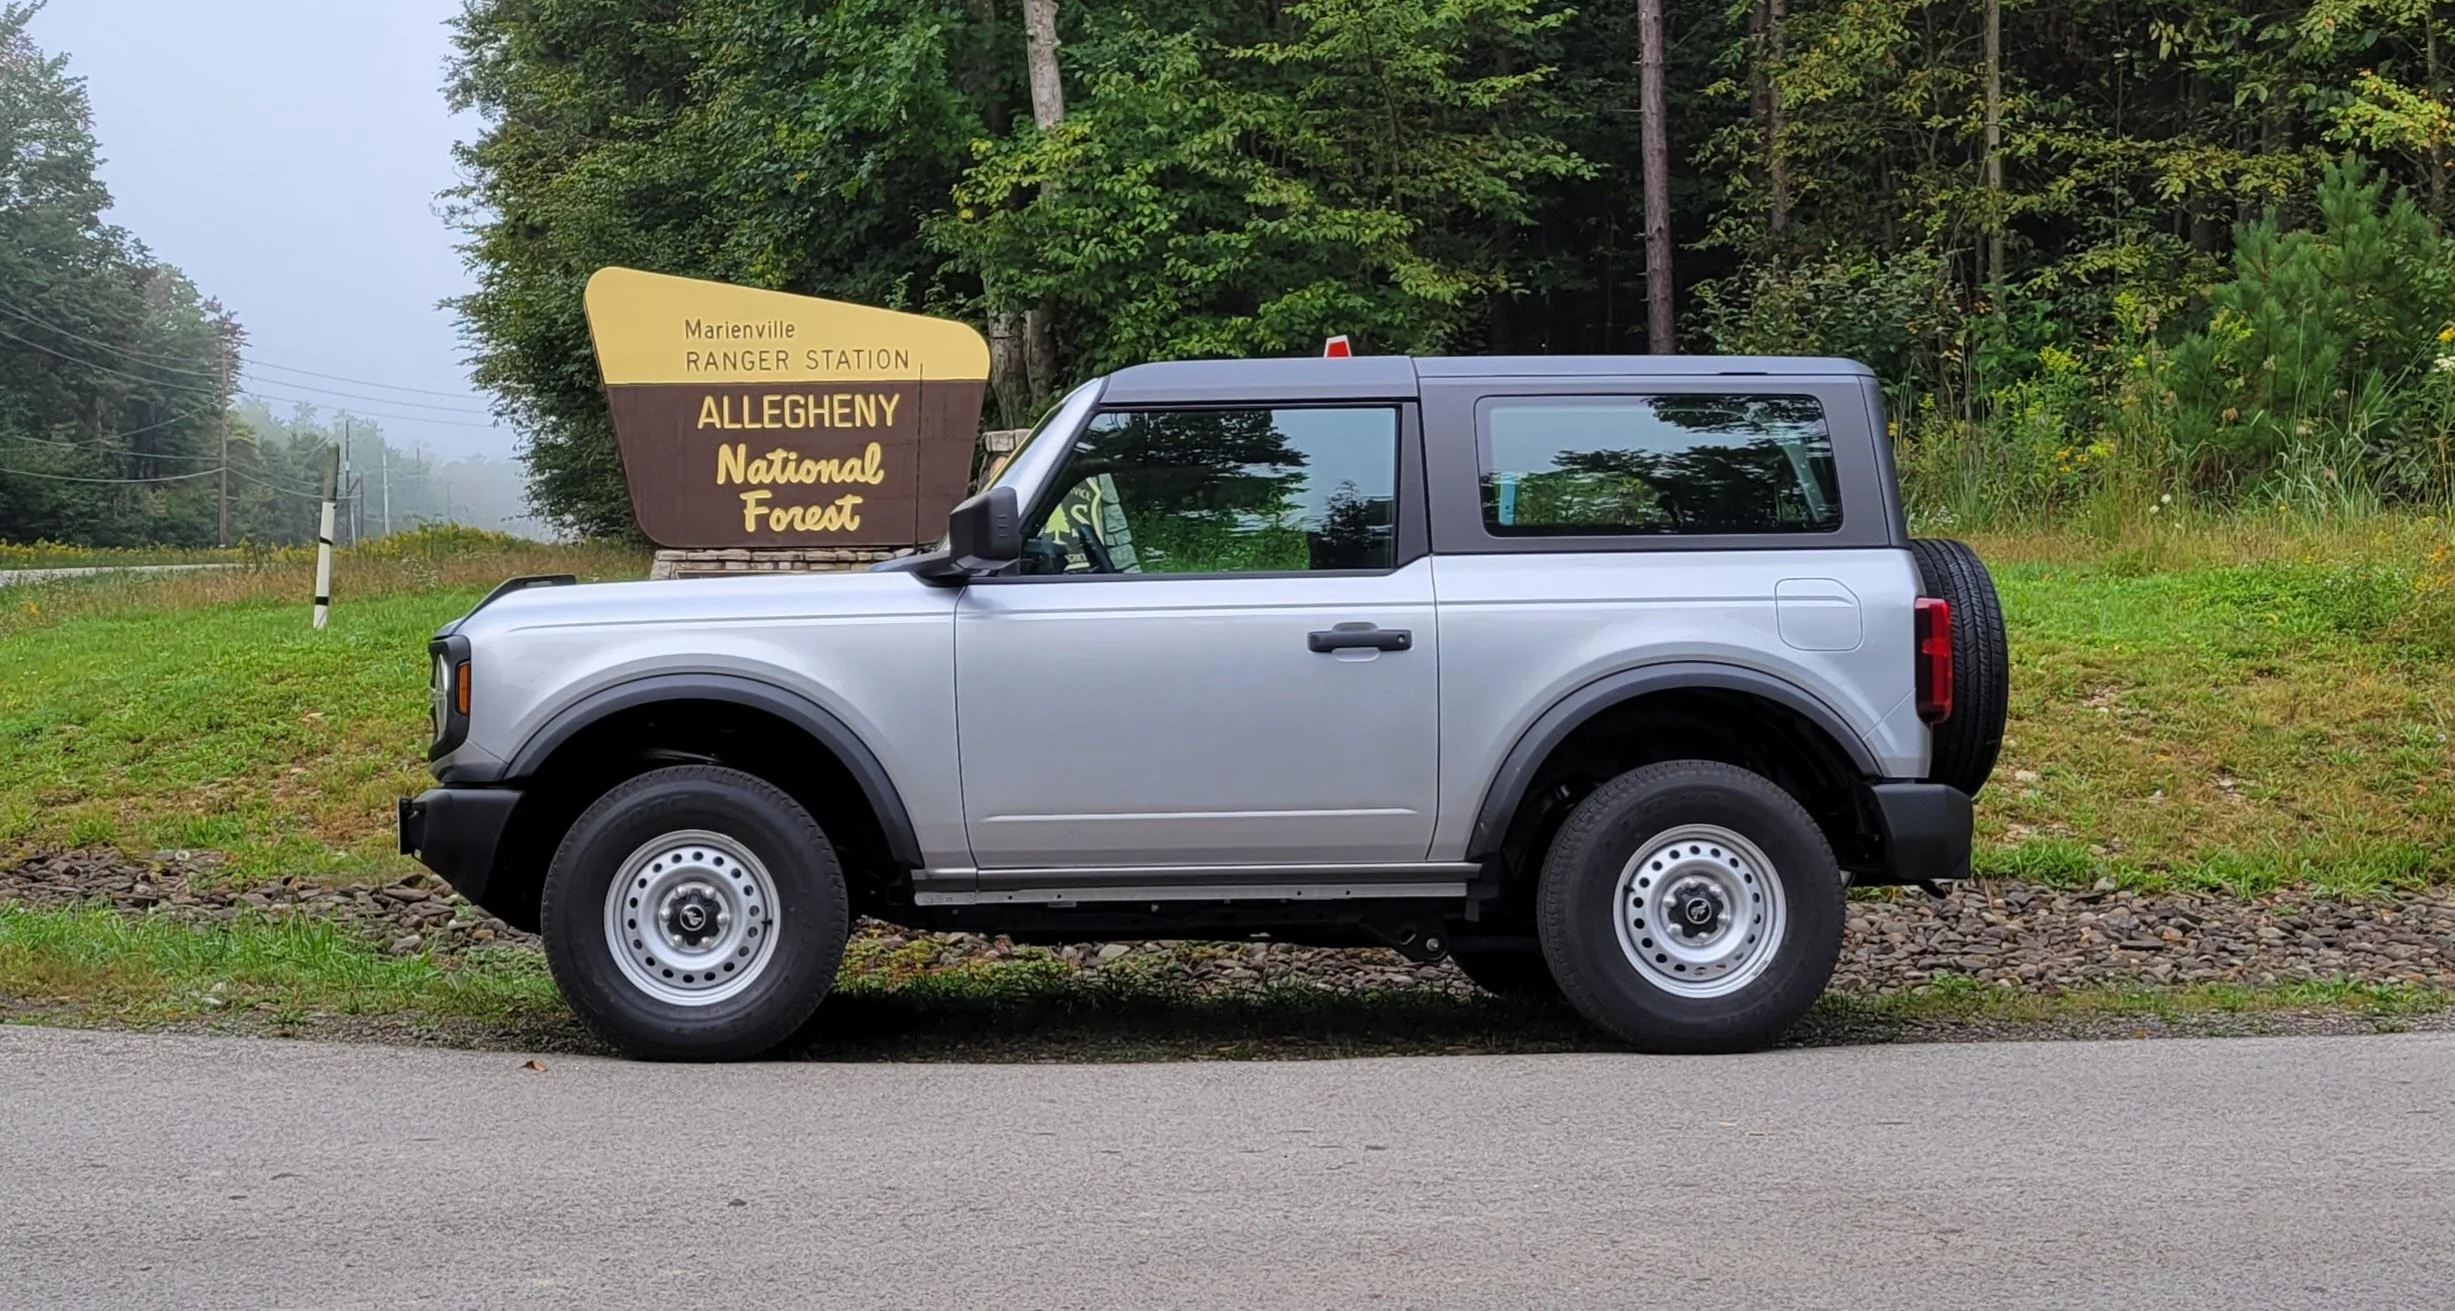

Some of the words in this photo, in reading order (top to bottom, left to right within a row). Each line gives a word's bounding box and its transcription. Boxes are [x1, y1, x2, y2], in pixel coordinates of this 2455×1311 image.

[684, 319, 796, 340] Marienville
[686, 350, 790, 371] RANGER
[805, 348, 910, 370] STATION
[697, 393, 900, 429] ALLEGHENY
[716, 441, 885, 485] National
[739, 489, 864, 533] Forest
